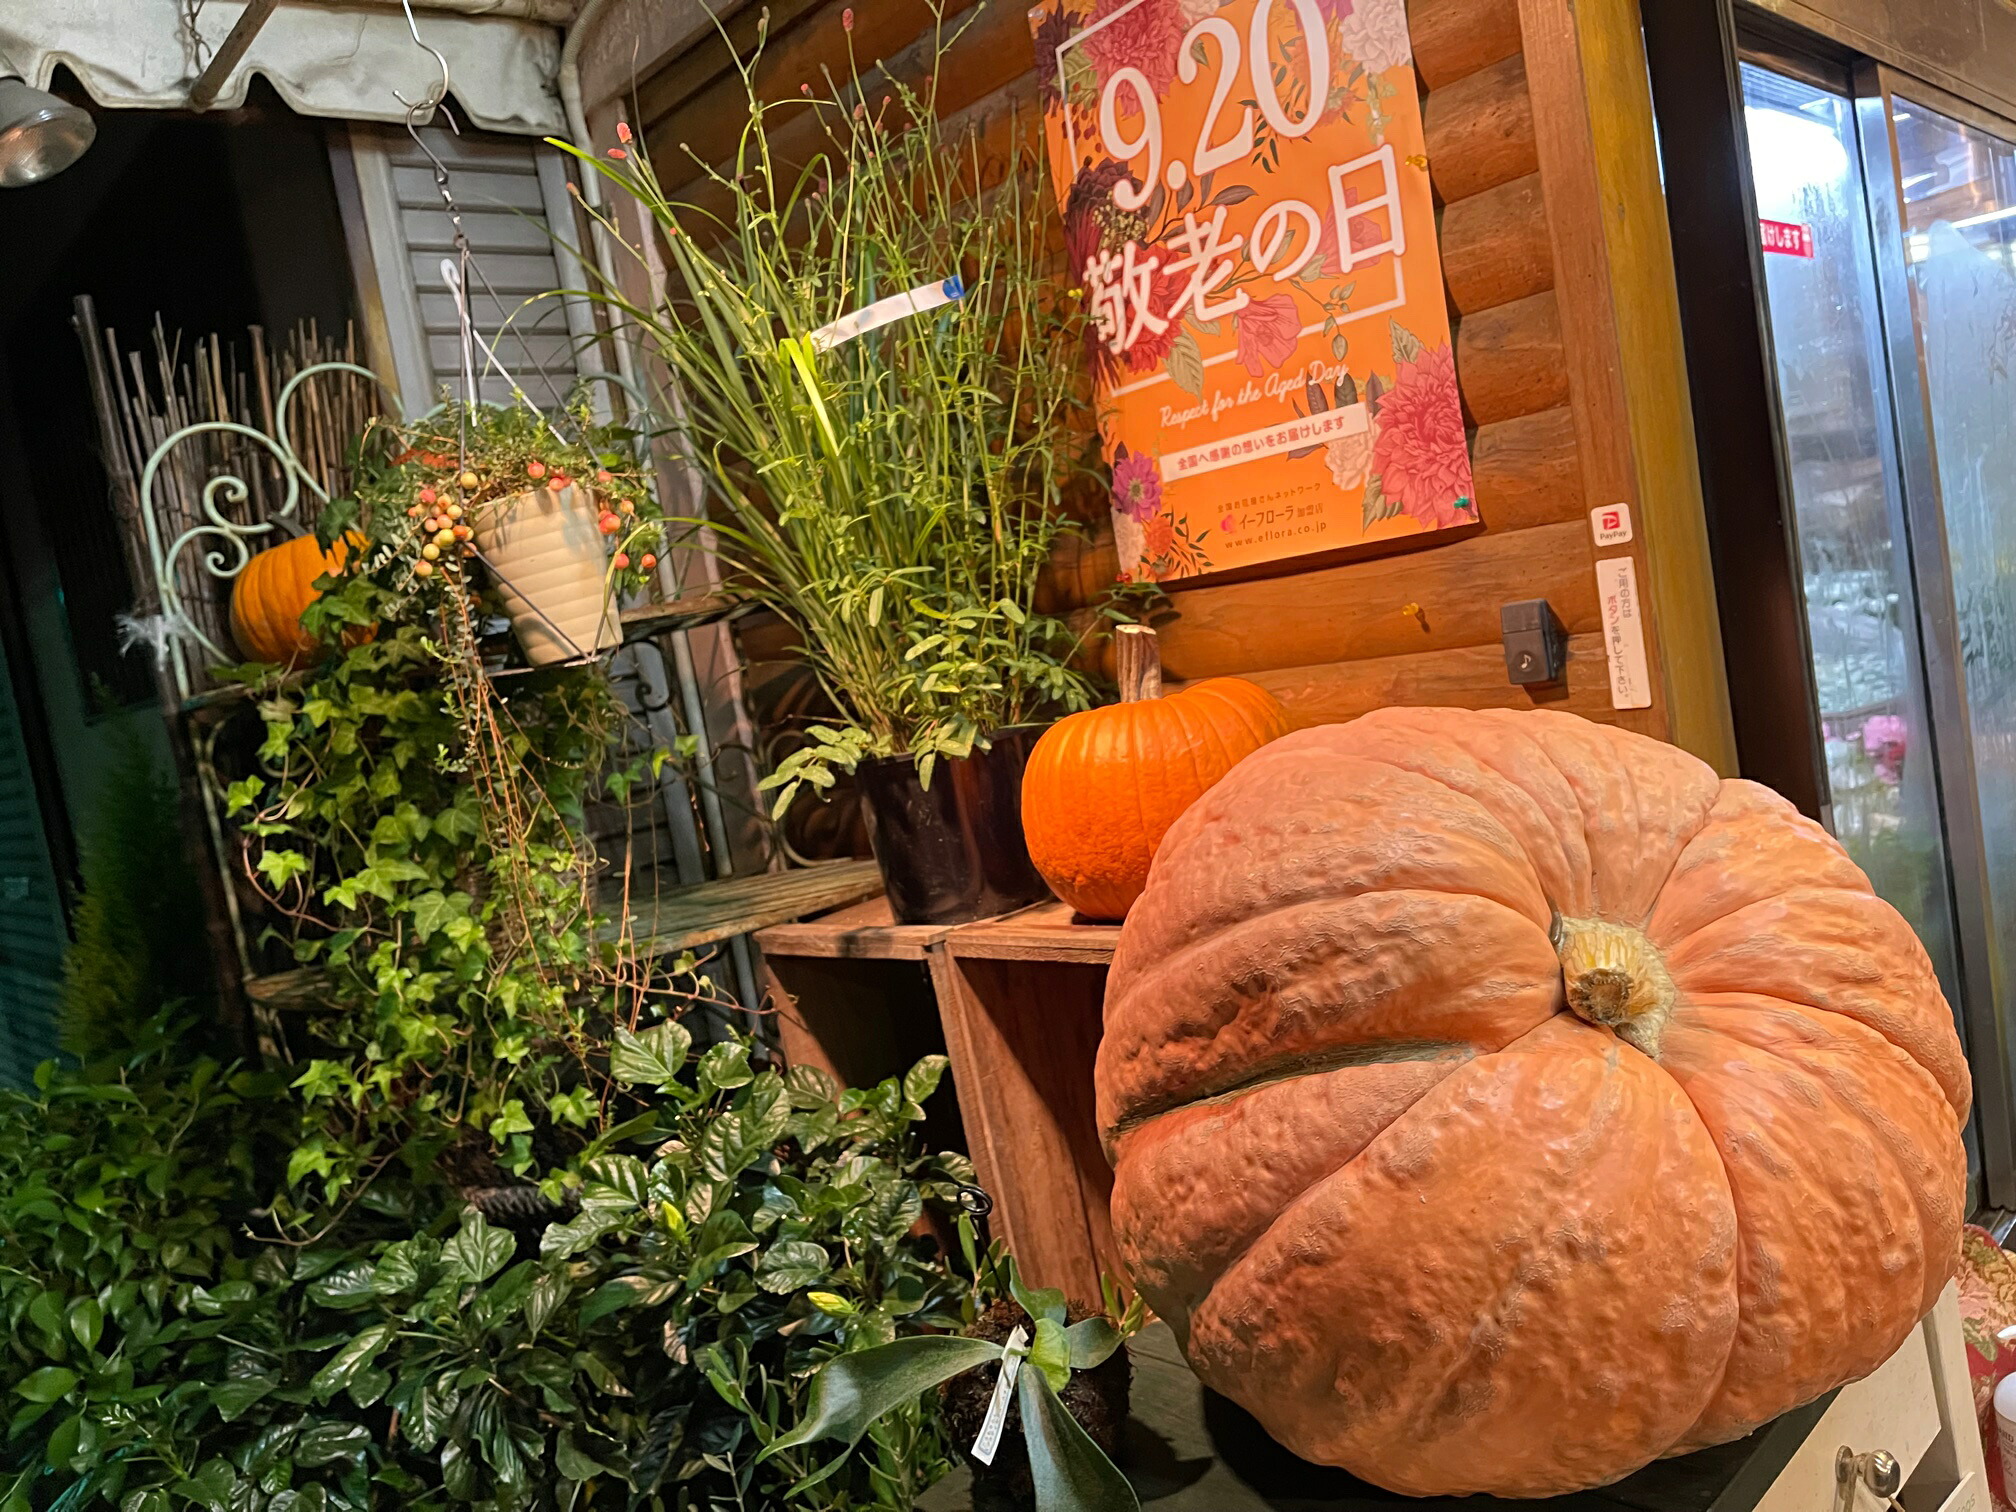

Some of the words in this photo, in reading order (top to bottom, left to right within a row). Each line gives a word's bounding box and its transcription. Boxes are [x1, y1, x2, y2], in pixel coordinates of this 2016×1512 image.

[1101, 0, 1330, 211] 9.20
[1082, 144, 1407, 355] 敬老の日
[1160, 401, 1210, 430] Respect
[1211, 390, 1235, 422] for
[1237, 381, 1263, 406] the
[1264, 367, 1306, 403] Aged
[1308, 360, 1350, 387] Day
[1177, 416, 1345, 471] 全国へ感謝の想いをお届けします
[1225, 521, 1327, 549] www.eflora.co.jp
[1239, 505, 1294, 530] イーフローラ
[1600, 530, 1627, 540] PayPay
